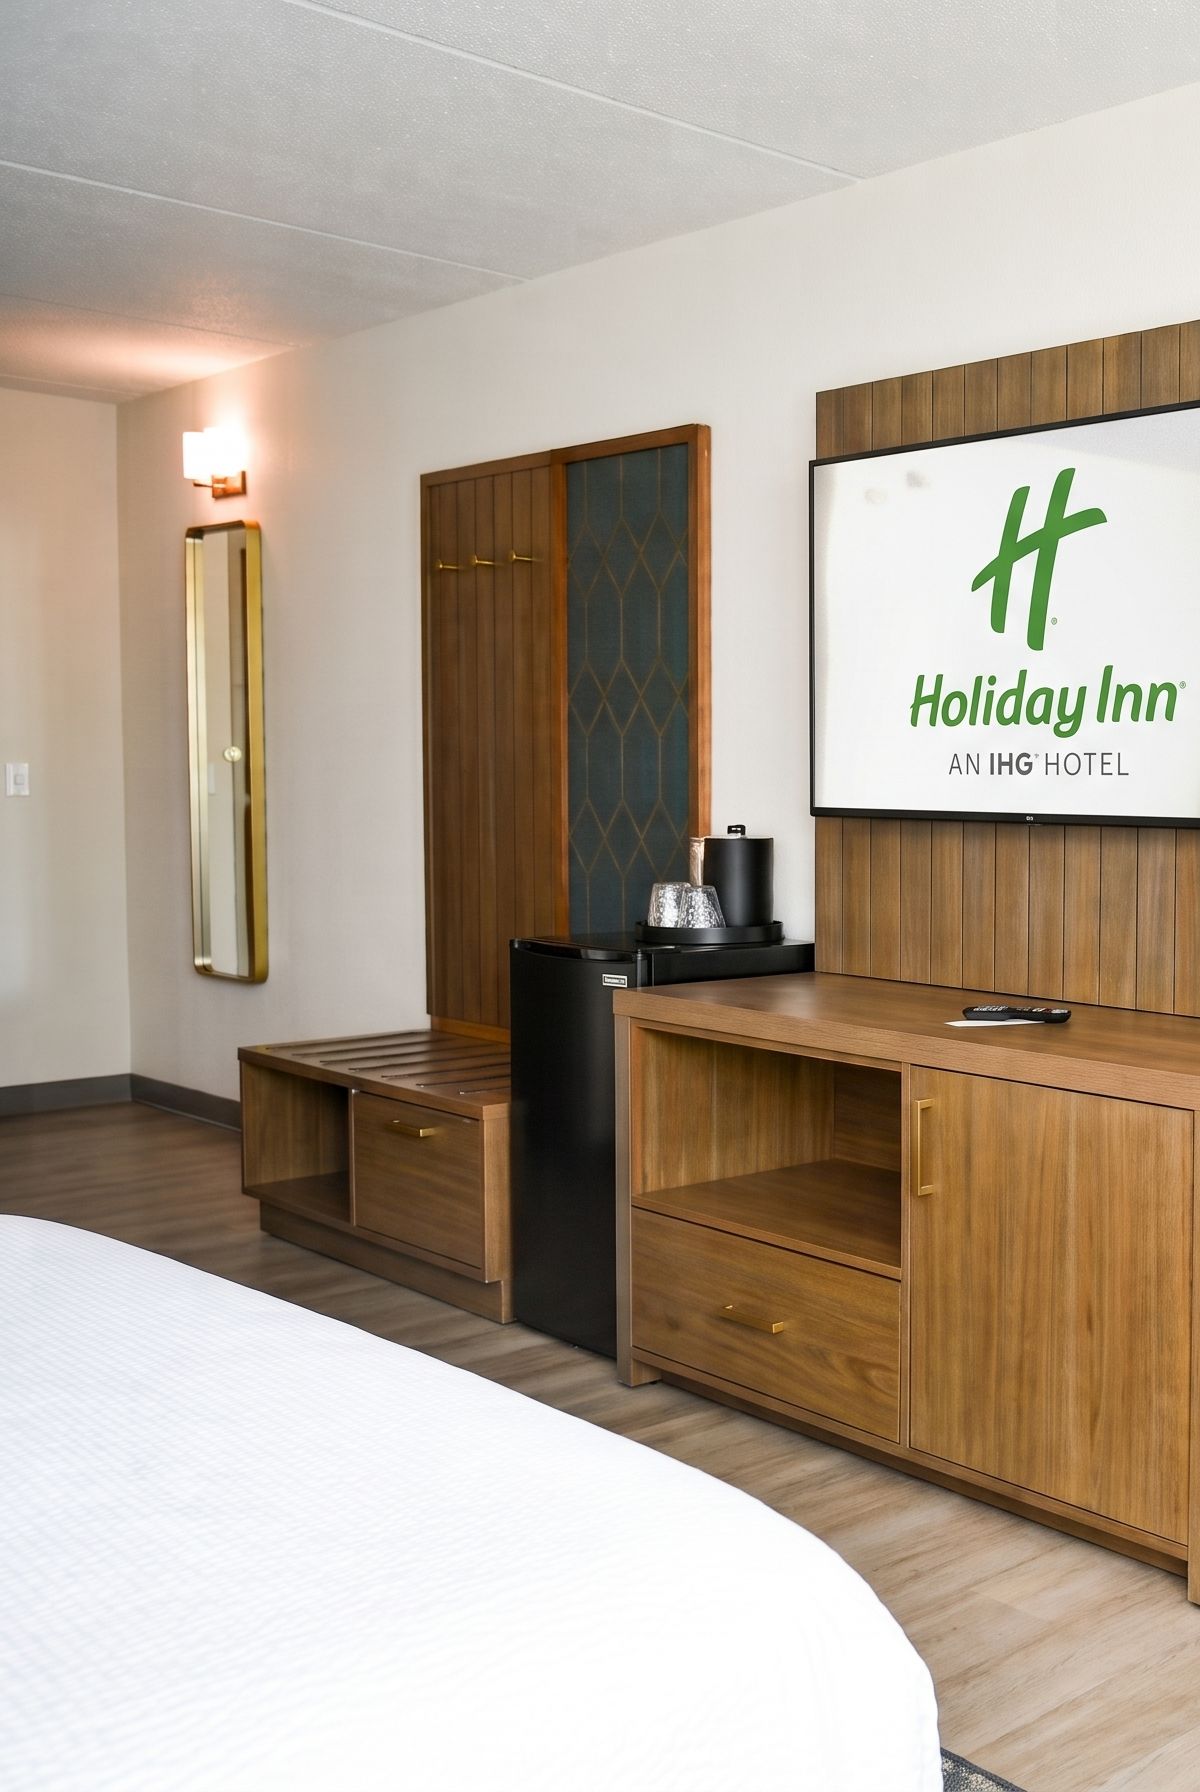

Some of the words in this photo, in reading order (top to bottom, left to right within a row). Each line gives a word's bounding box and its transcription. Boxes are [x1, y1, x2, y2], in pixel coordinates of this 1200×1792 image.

[971, 467, 1108, 652] H
[910, 669, 1088, 739] Holiday
[1095, 665, 1178, 724] Inn
[948, 753, 980, 776] AN
[989, 753, 1034, 776] IHG
[1045, 752, 1130, 776] HOTEL
